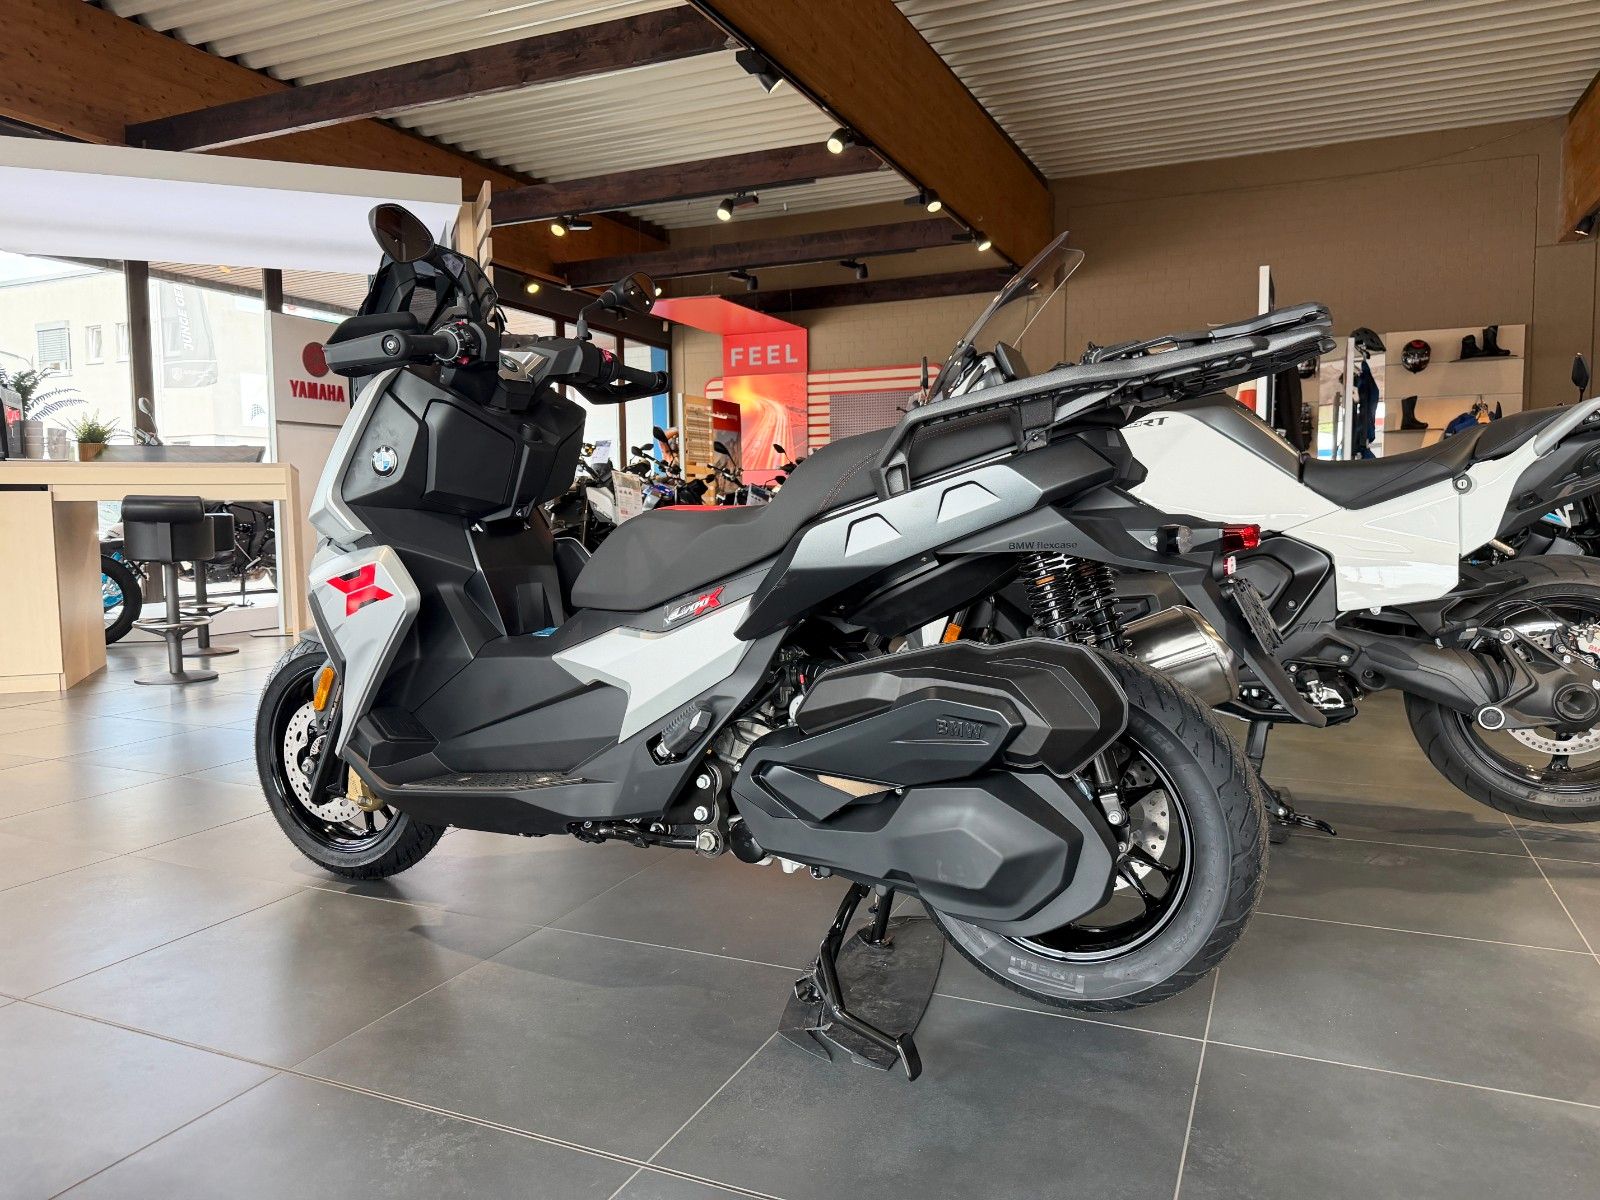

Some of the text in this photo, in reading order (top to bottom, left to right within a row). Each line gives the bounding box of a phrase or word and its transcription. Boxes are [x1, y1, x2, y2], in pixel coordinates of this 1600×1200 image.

[730, 343, 799, 368] FEEL
[289, 379, 346, 403] YAMAHA
[1008, 541, 1078, 550] BMW flexcase
[935, 718, 983, 740] BMW
